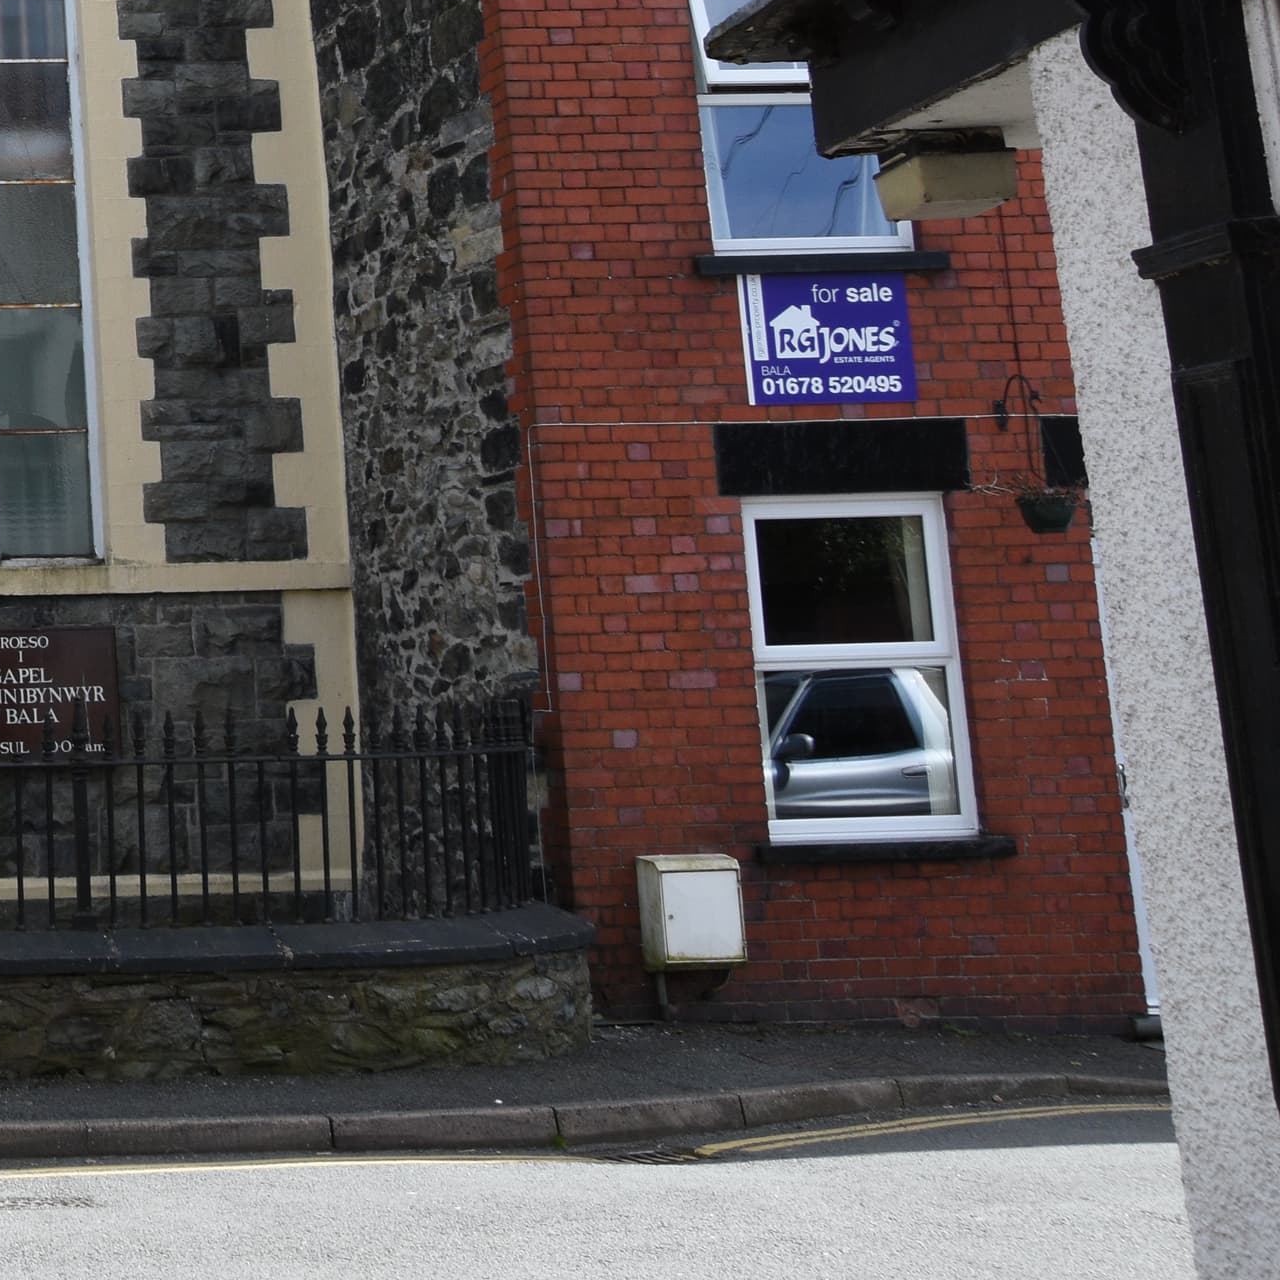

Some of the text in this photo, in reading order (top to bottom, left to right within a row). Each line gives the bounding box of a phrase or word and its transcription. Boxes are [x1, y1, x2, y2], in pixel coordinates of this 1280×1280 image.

[811, 282, 893, 303] for sale
[779, 325, 898, 364] RG JONES
[833, 355, 896, 364] ESTATE AGENTS
[761, 365, 791, 377] BALA
[762, 375, 902, 396] 01678 520495
[6, 708, 60, 725] BALA
[0, 741, 29, 755] SUL
